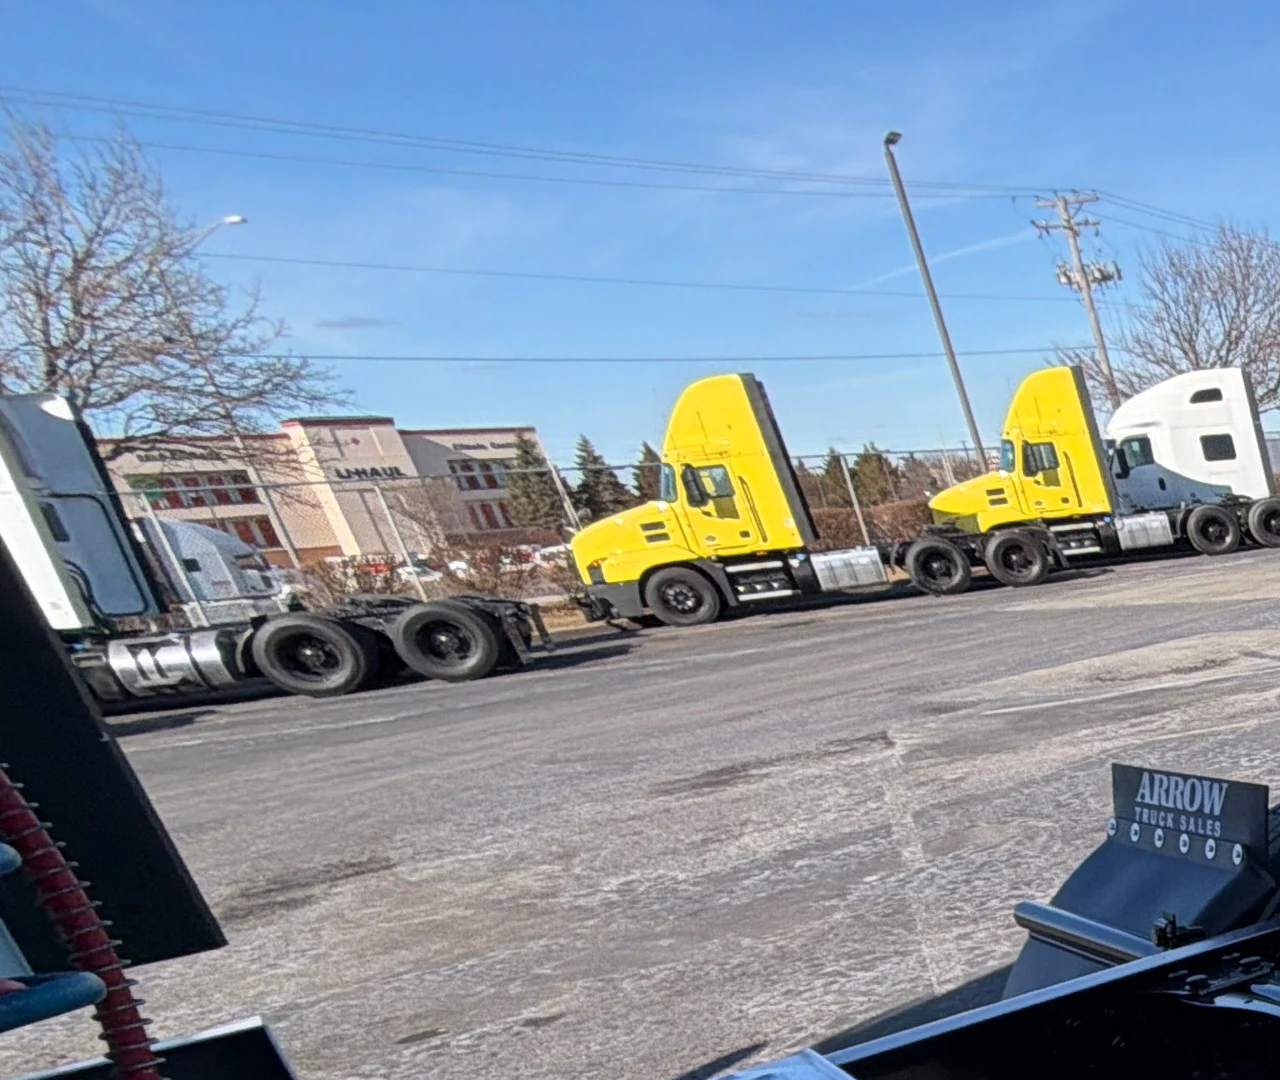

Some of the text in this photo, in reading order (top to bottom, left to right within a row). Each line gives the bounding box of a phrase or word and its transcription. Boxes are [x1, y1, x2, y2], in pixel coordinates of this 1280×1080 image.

[1135, 771, 1229, 816] ARROW
[1134, 807, 1221, 838] TRUCK SALES
